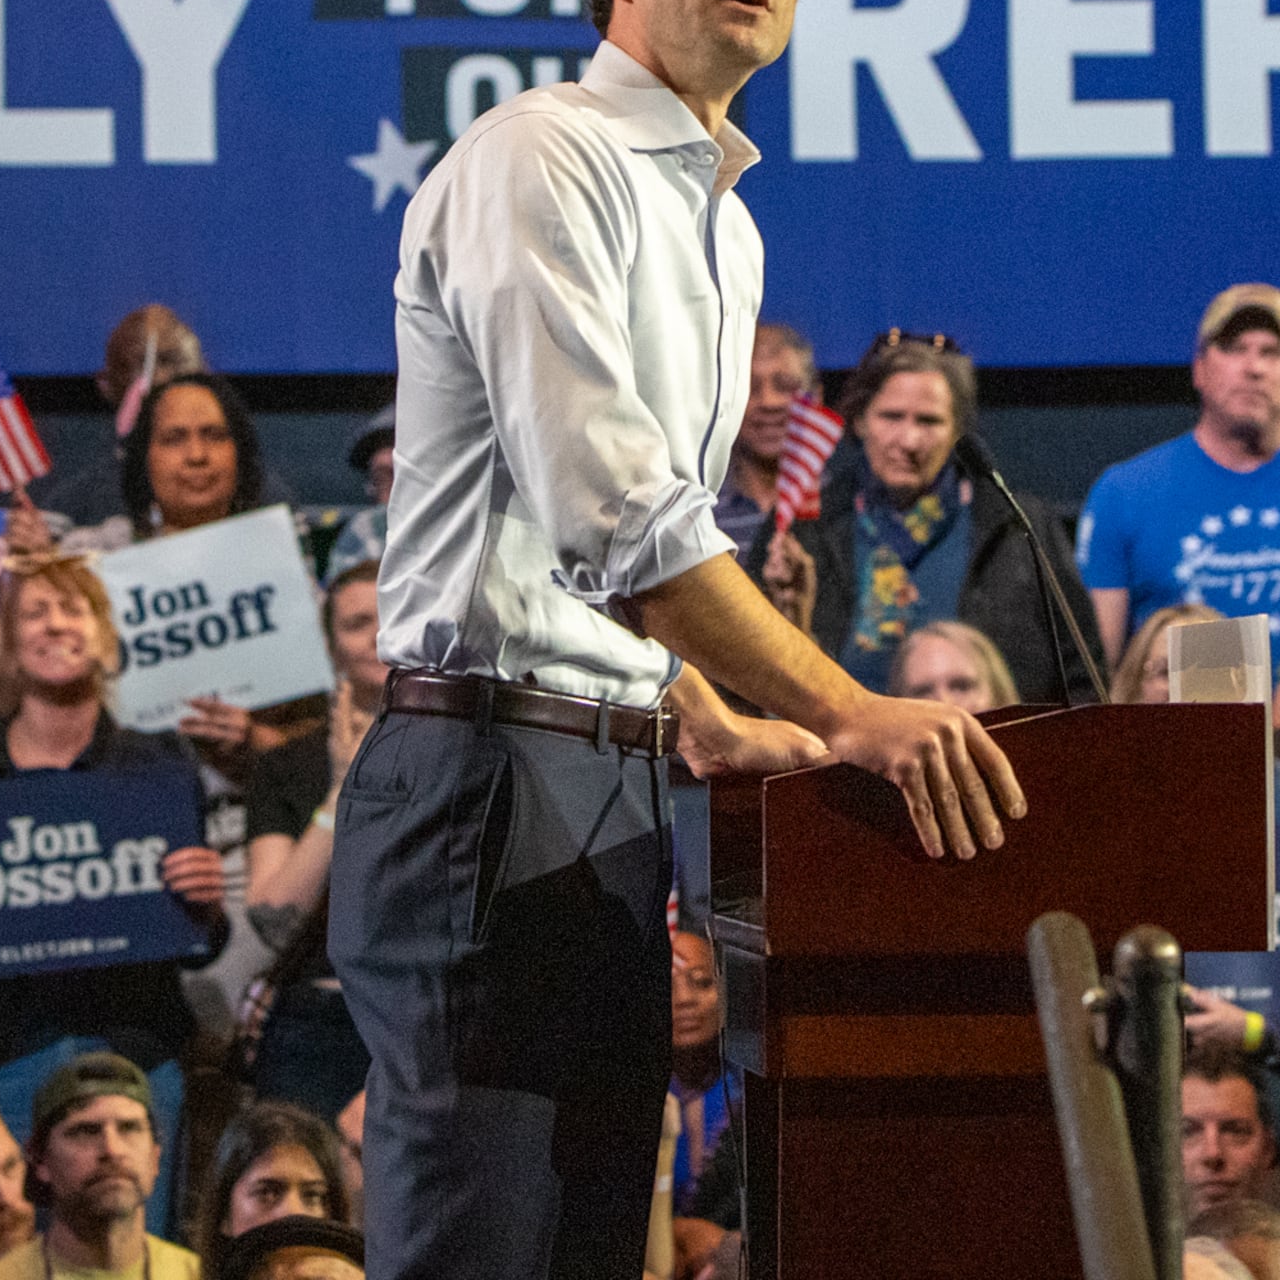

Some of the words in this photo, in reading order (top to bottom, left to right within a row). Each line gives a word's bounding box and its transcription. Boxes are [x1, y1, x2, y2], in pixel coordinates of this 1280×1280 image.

[124, 579, 210, 625] Jon
[119, 583, 277, 677] ssoff
[0, 816, 102, 862] Jon
